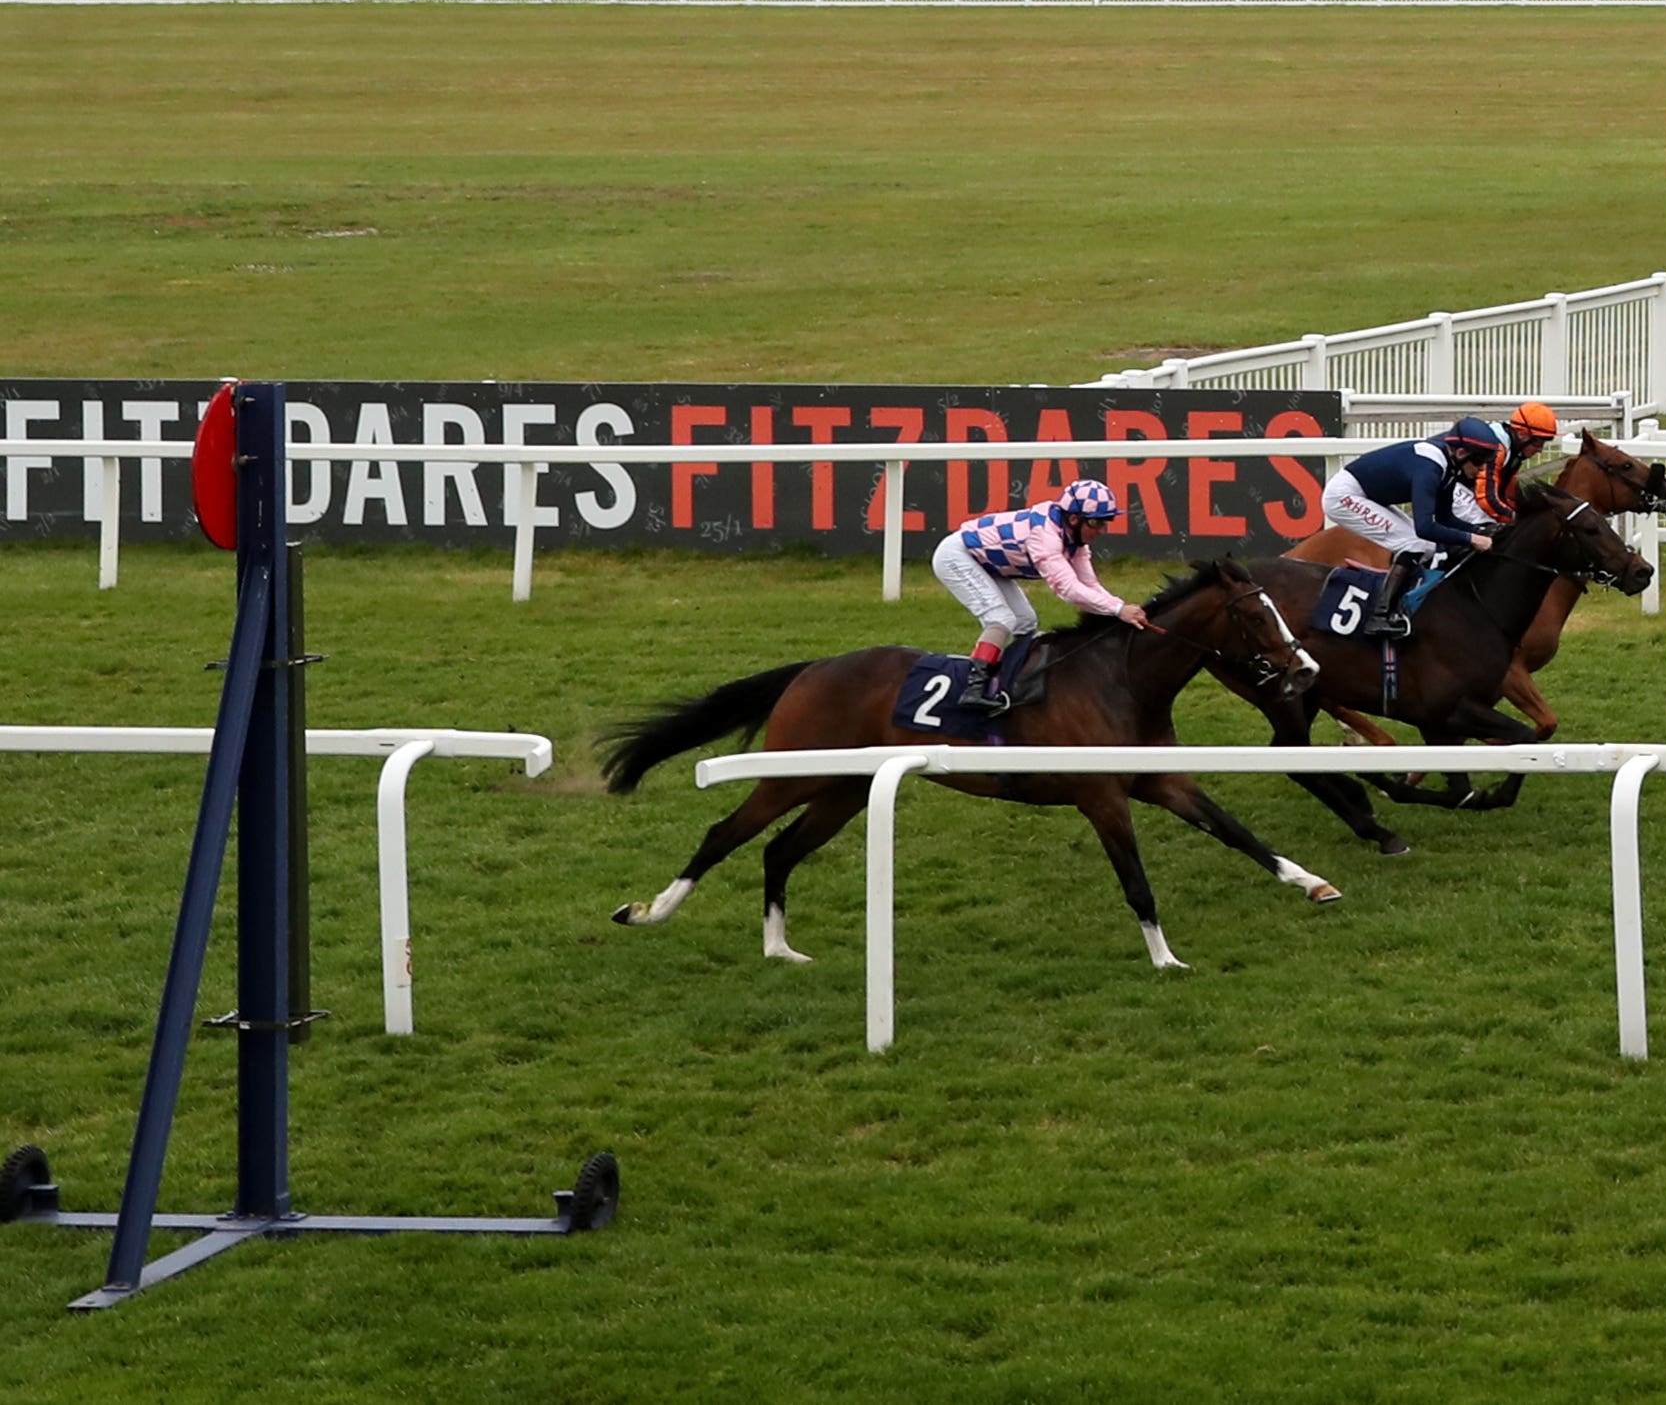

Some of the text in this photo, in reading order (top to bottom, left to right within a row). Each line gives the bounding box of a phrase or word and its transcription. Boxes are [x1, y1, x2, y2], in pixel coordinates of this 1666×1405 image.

[5, 399, 637, 530] FITDARES
[670, 404, 1324, 540] FITZDARES
[1339, 495, 1394, 532] BAHRAIN
[1330, 584, 1370, 636] 5
[912, 674, 952, 728] 2
